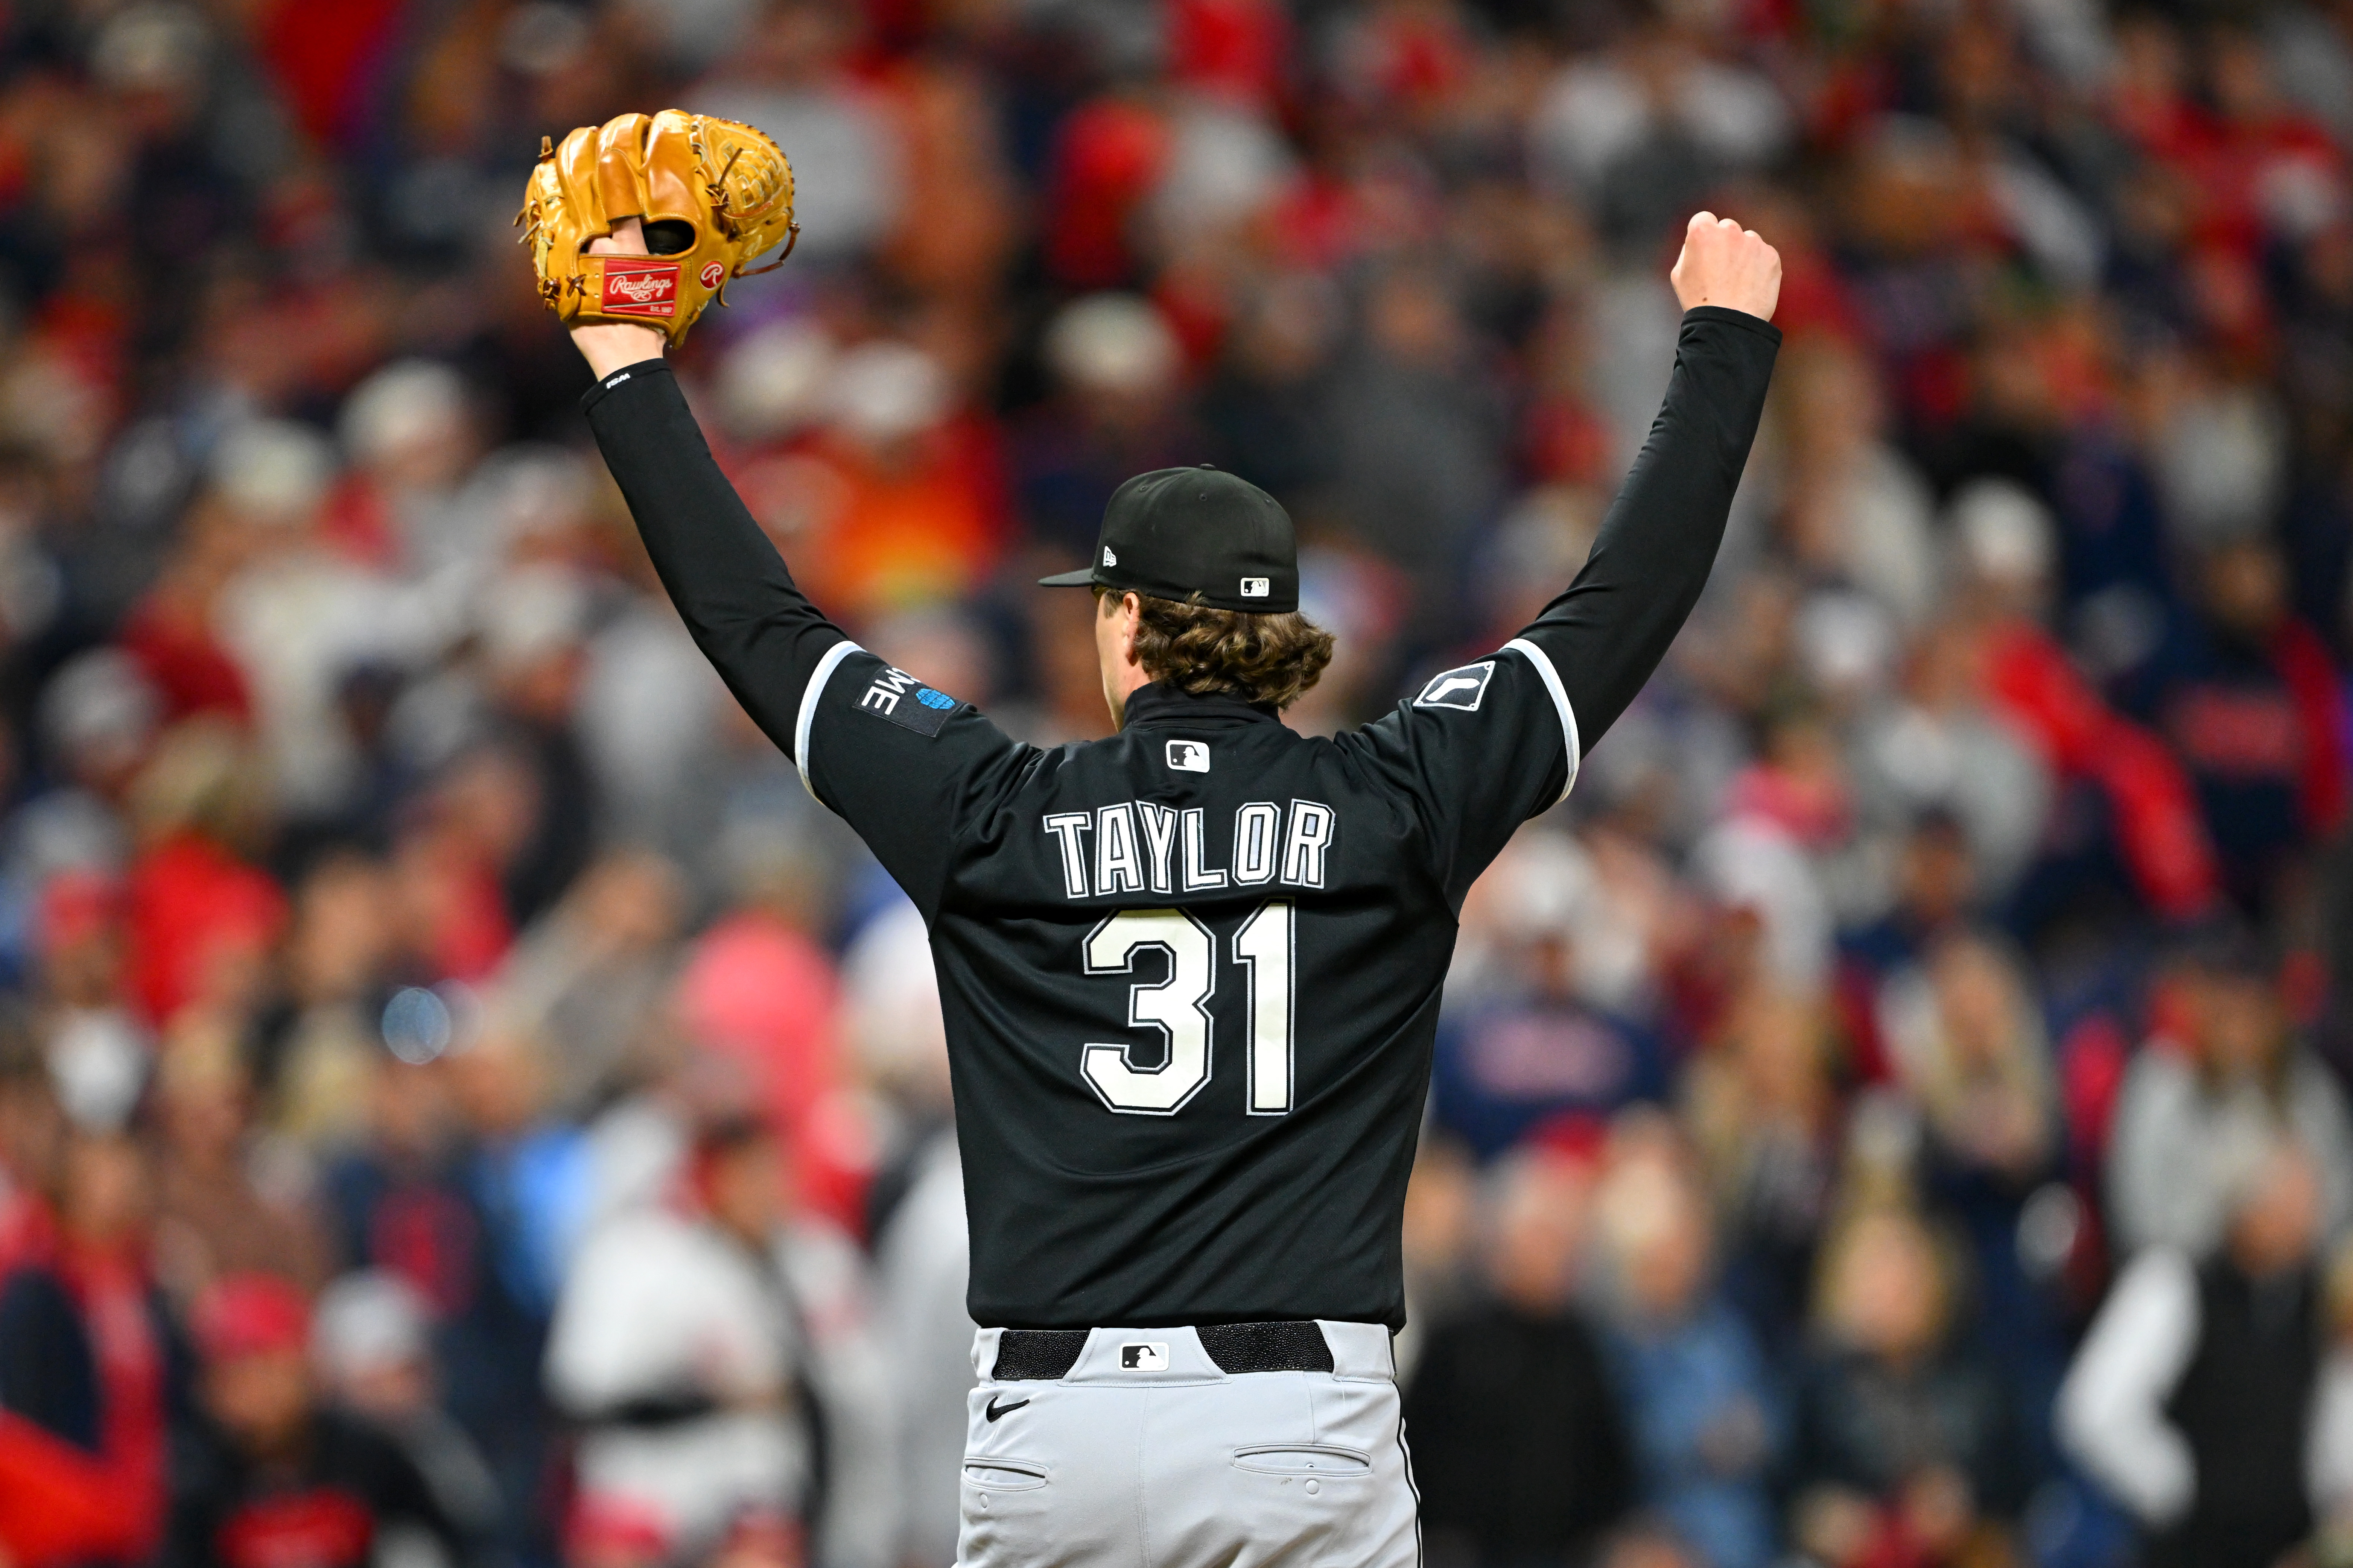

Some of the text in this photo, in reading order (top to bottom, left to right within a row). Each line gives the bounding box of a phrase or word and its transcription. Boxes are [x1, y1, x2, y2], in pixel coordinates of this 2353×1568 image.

[610, 274, 673, 297] Rawlings
[1043, 798, 1335, 899] TAYLOR
[1080, 896, 1296, 1117] 31
